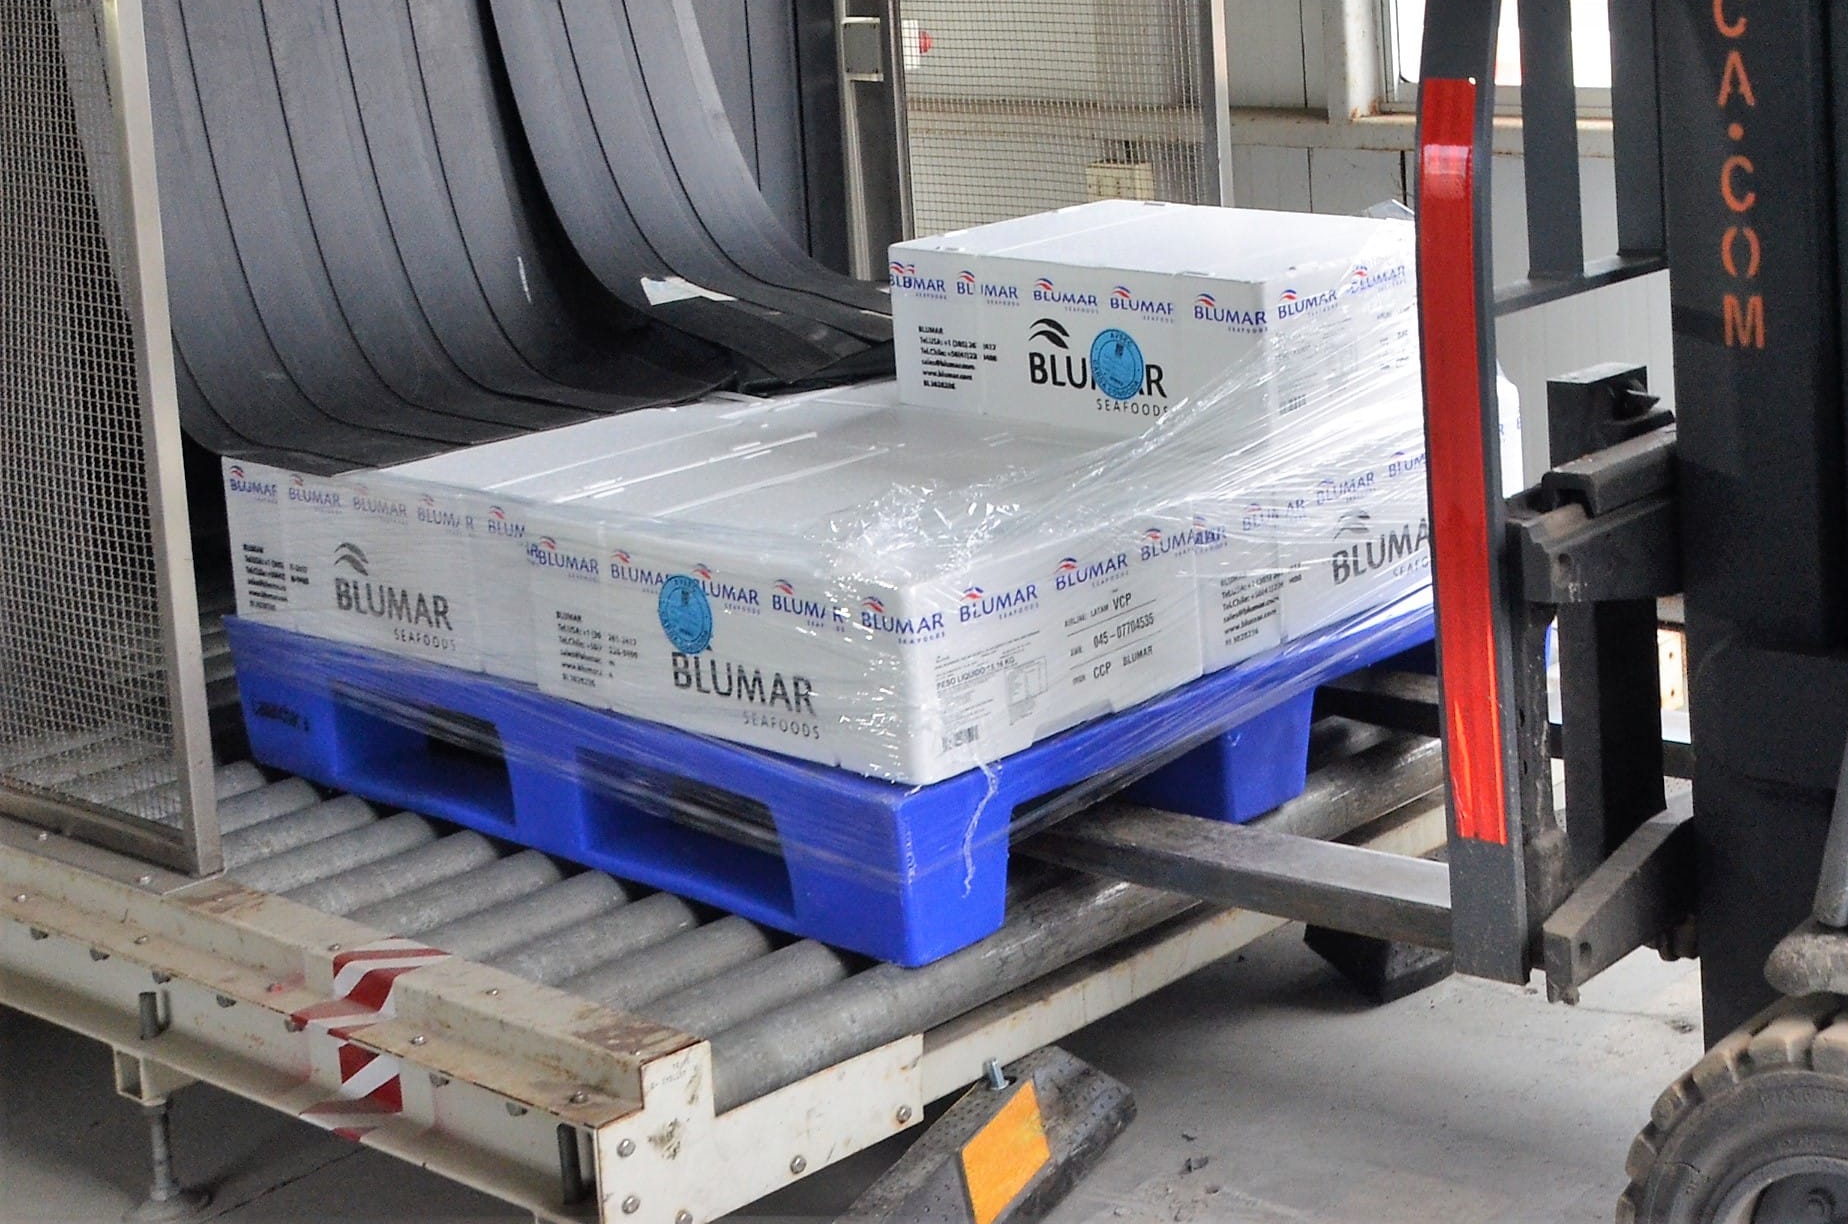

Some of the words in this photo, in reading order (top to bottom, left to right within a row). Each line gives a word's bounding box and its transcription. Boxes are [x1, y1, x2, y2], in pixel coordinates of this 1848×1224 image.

[1033, 290, 1098, 306] BLUMAR
[1278, 289, 1337, 320] BLUMAR
[1193, 304, 1266, 326] BLUMAR
[1028, 352, 1168, 398] BLUR
[288, 487, 342, 507] BLUMAR
[353, 496, 408, 518] BLUMAR
[538, 550, 600, 576] BLUMAR
[1332, 517, 1430, 585] BLUMA
[610, 563, 669, 586] BLUMA
[1056, 553, 1128, 591] BLUMAR
[334, 578, 453, 631] BLUMAR
[696, 578, 760, 606] LUMAR
[959, 584, 1038, 624] BLUMAR
[1112, 592, 1132, 610] VCP
[861, 612, 945, 635] BLUMAR
[393, 628, 457, 652] SEAFOODS
[1093, 661, 1112, 679] CCP
[1122, 644, 1152, 666] BLUMAR
[672, 651, 816, 716] BLUMAR
[742, 710, 820, 740] SEAFOODS
